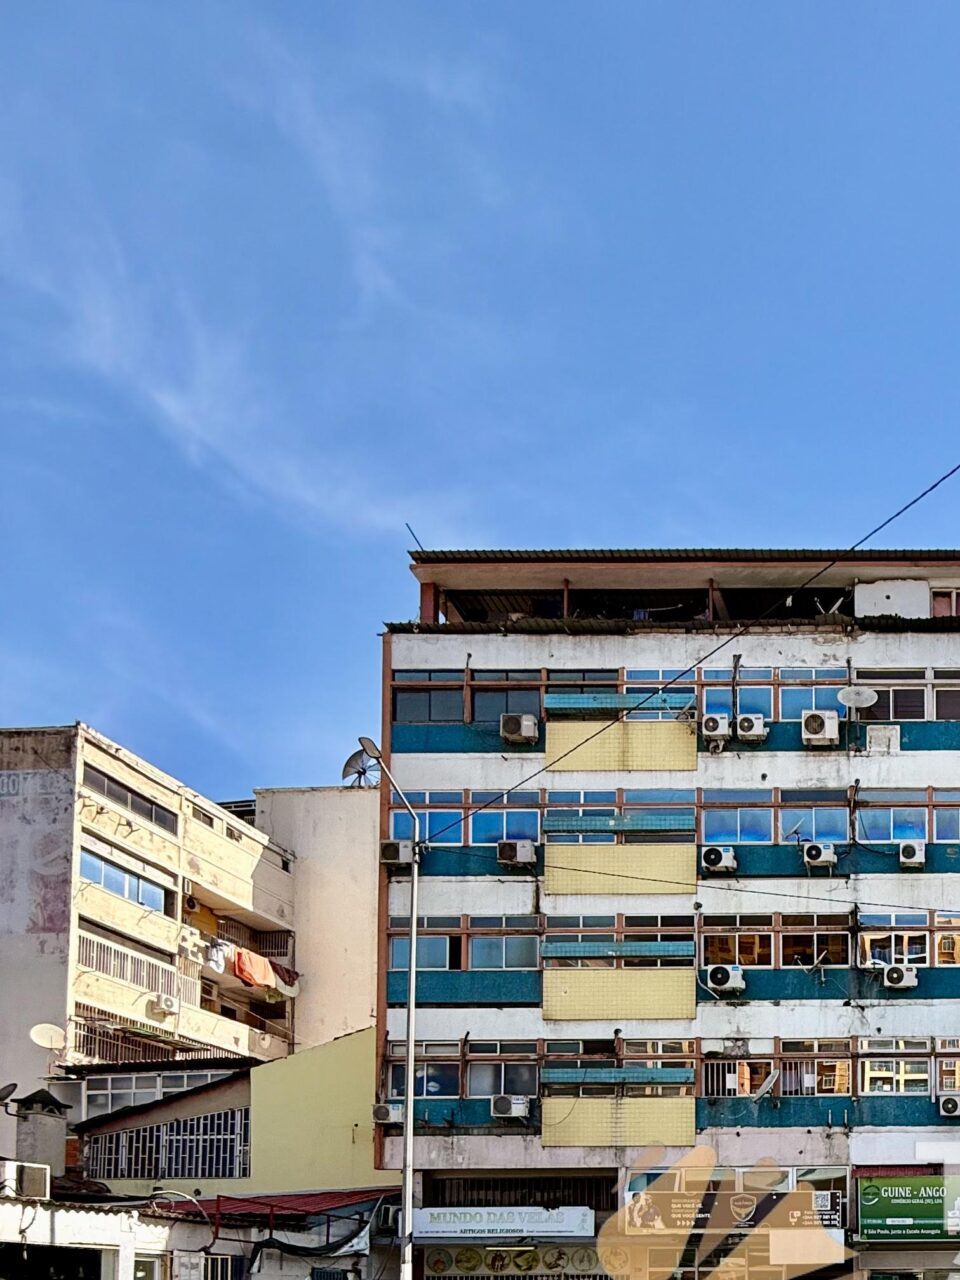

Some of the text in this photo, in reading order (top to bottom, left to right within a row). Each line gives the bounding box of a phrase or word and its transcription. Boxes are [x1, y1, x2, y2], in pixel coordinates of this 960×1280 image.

[881, 1186, 912, 1198] GUINE
[919, 1186, 947, 1198] ANGO
[429, 1212, 565, 1224] MUNDO DAS VELAS
